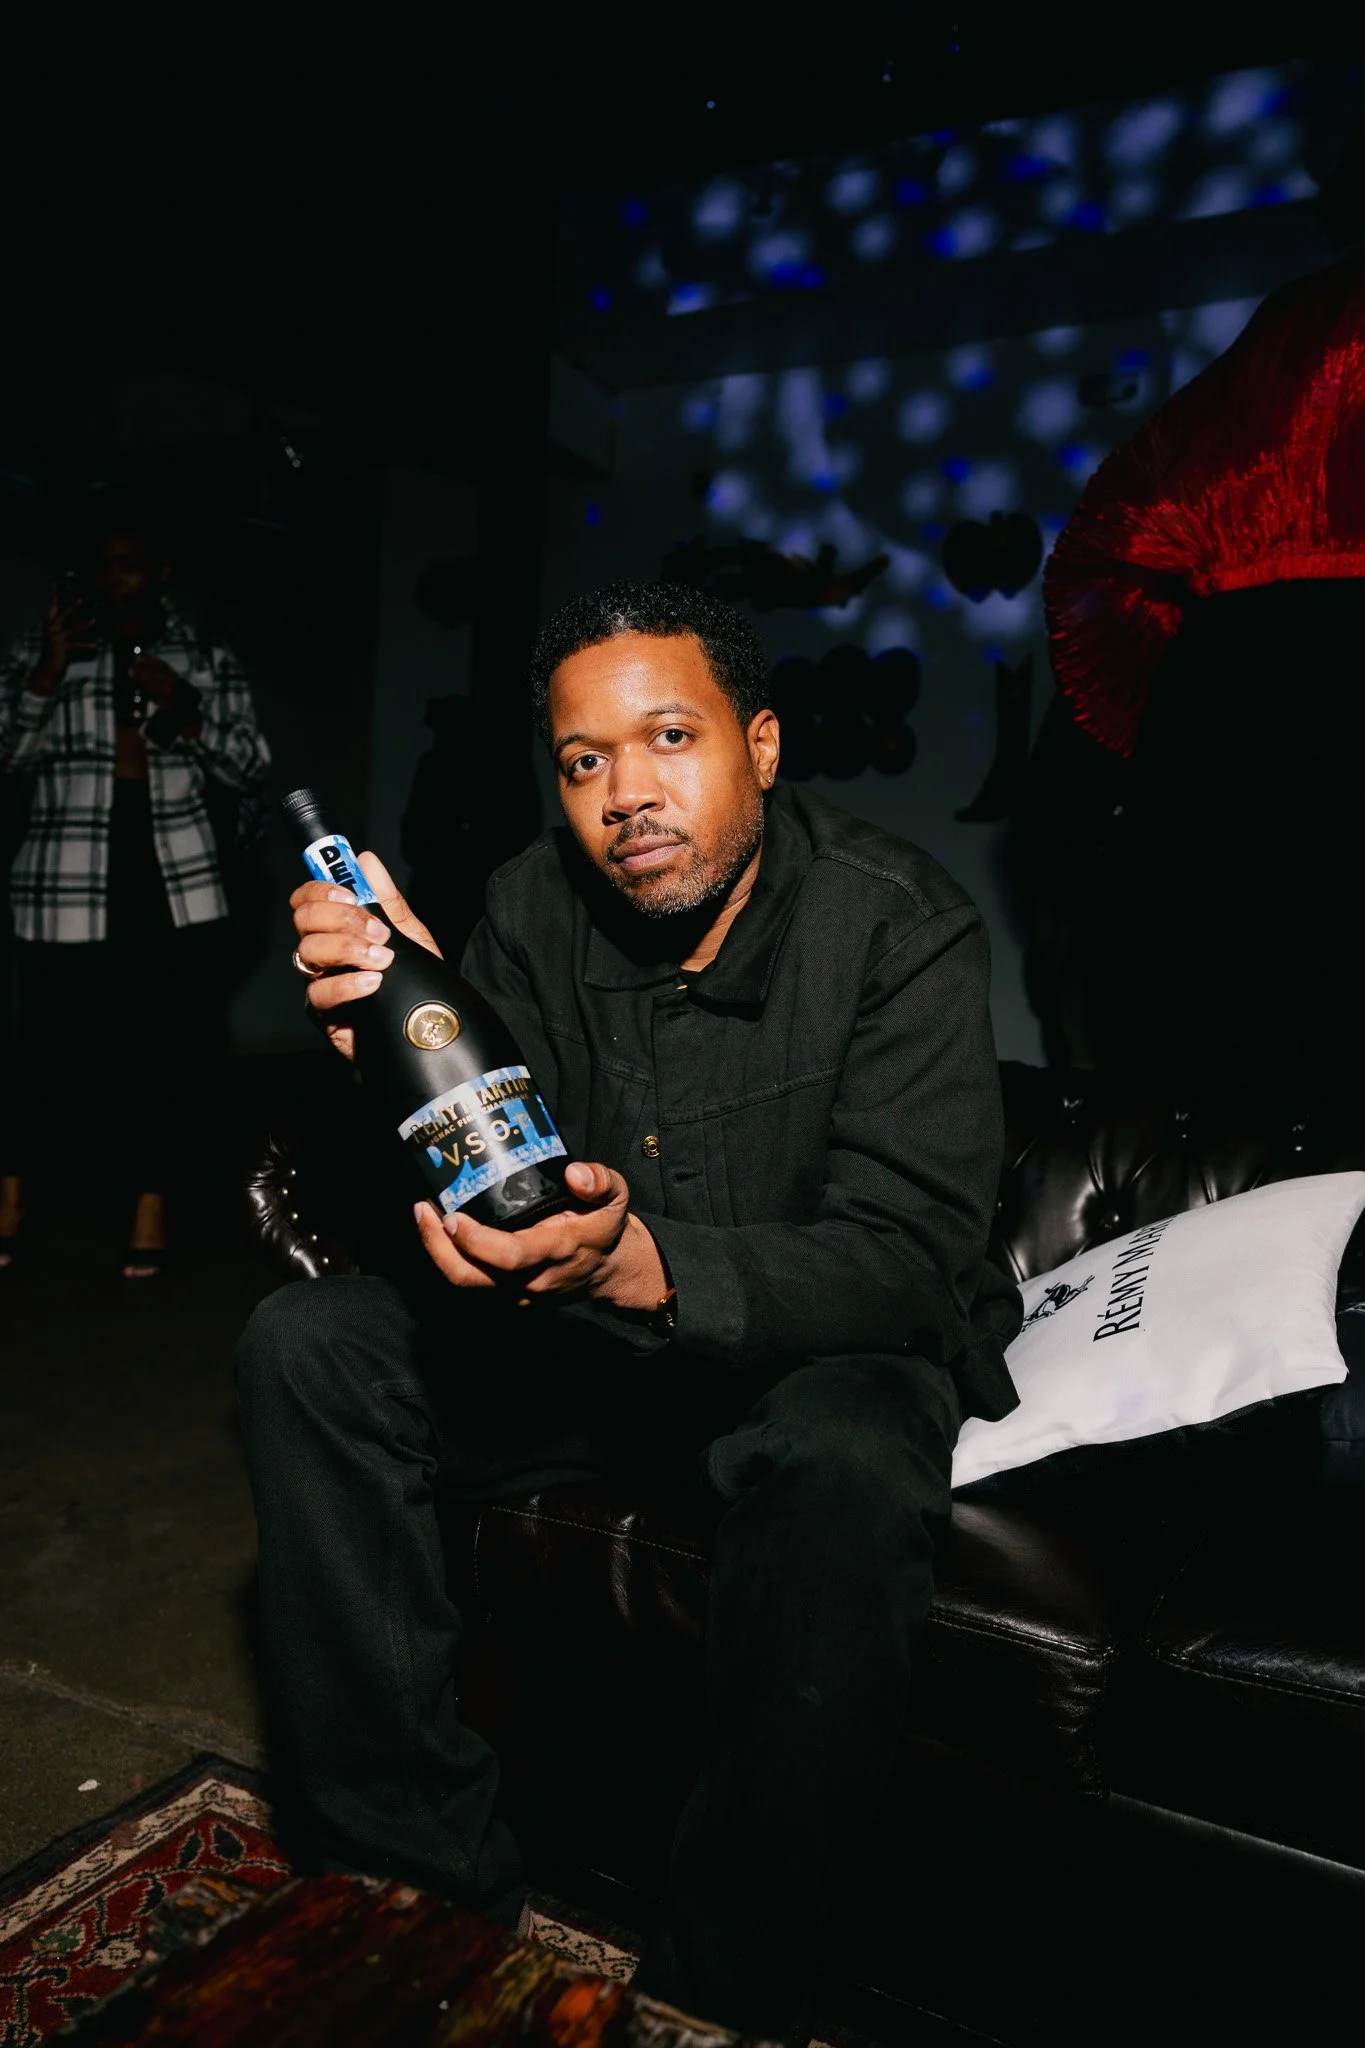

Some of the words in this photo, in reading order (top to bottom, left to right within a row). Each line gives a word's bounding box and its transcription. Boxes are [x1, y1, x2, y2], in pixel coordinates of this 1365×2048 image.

[460, 1077, 529, 1114] ARTIN
[427, 1125, 457, 1146] OGNAC
[457, 1112, 478, 1128] FIN
[442, 1111, 529, 1167] V.SO.P
[1093, 1265, 1149, 1342] RÉMY
